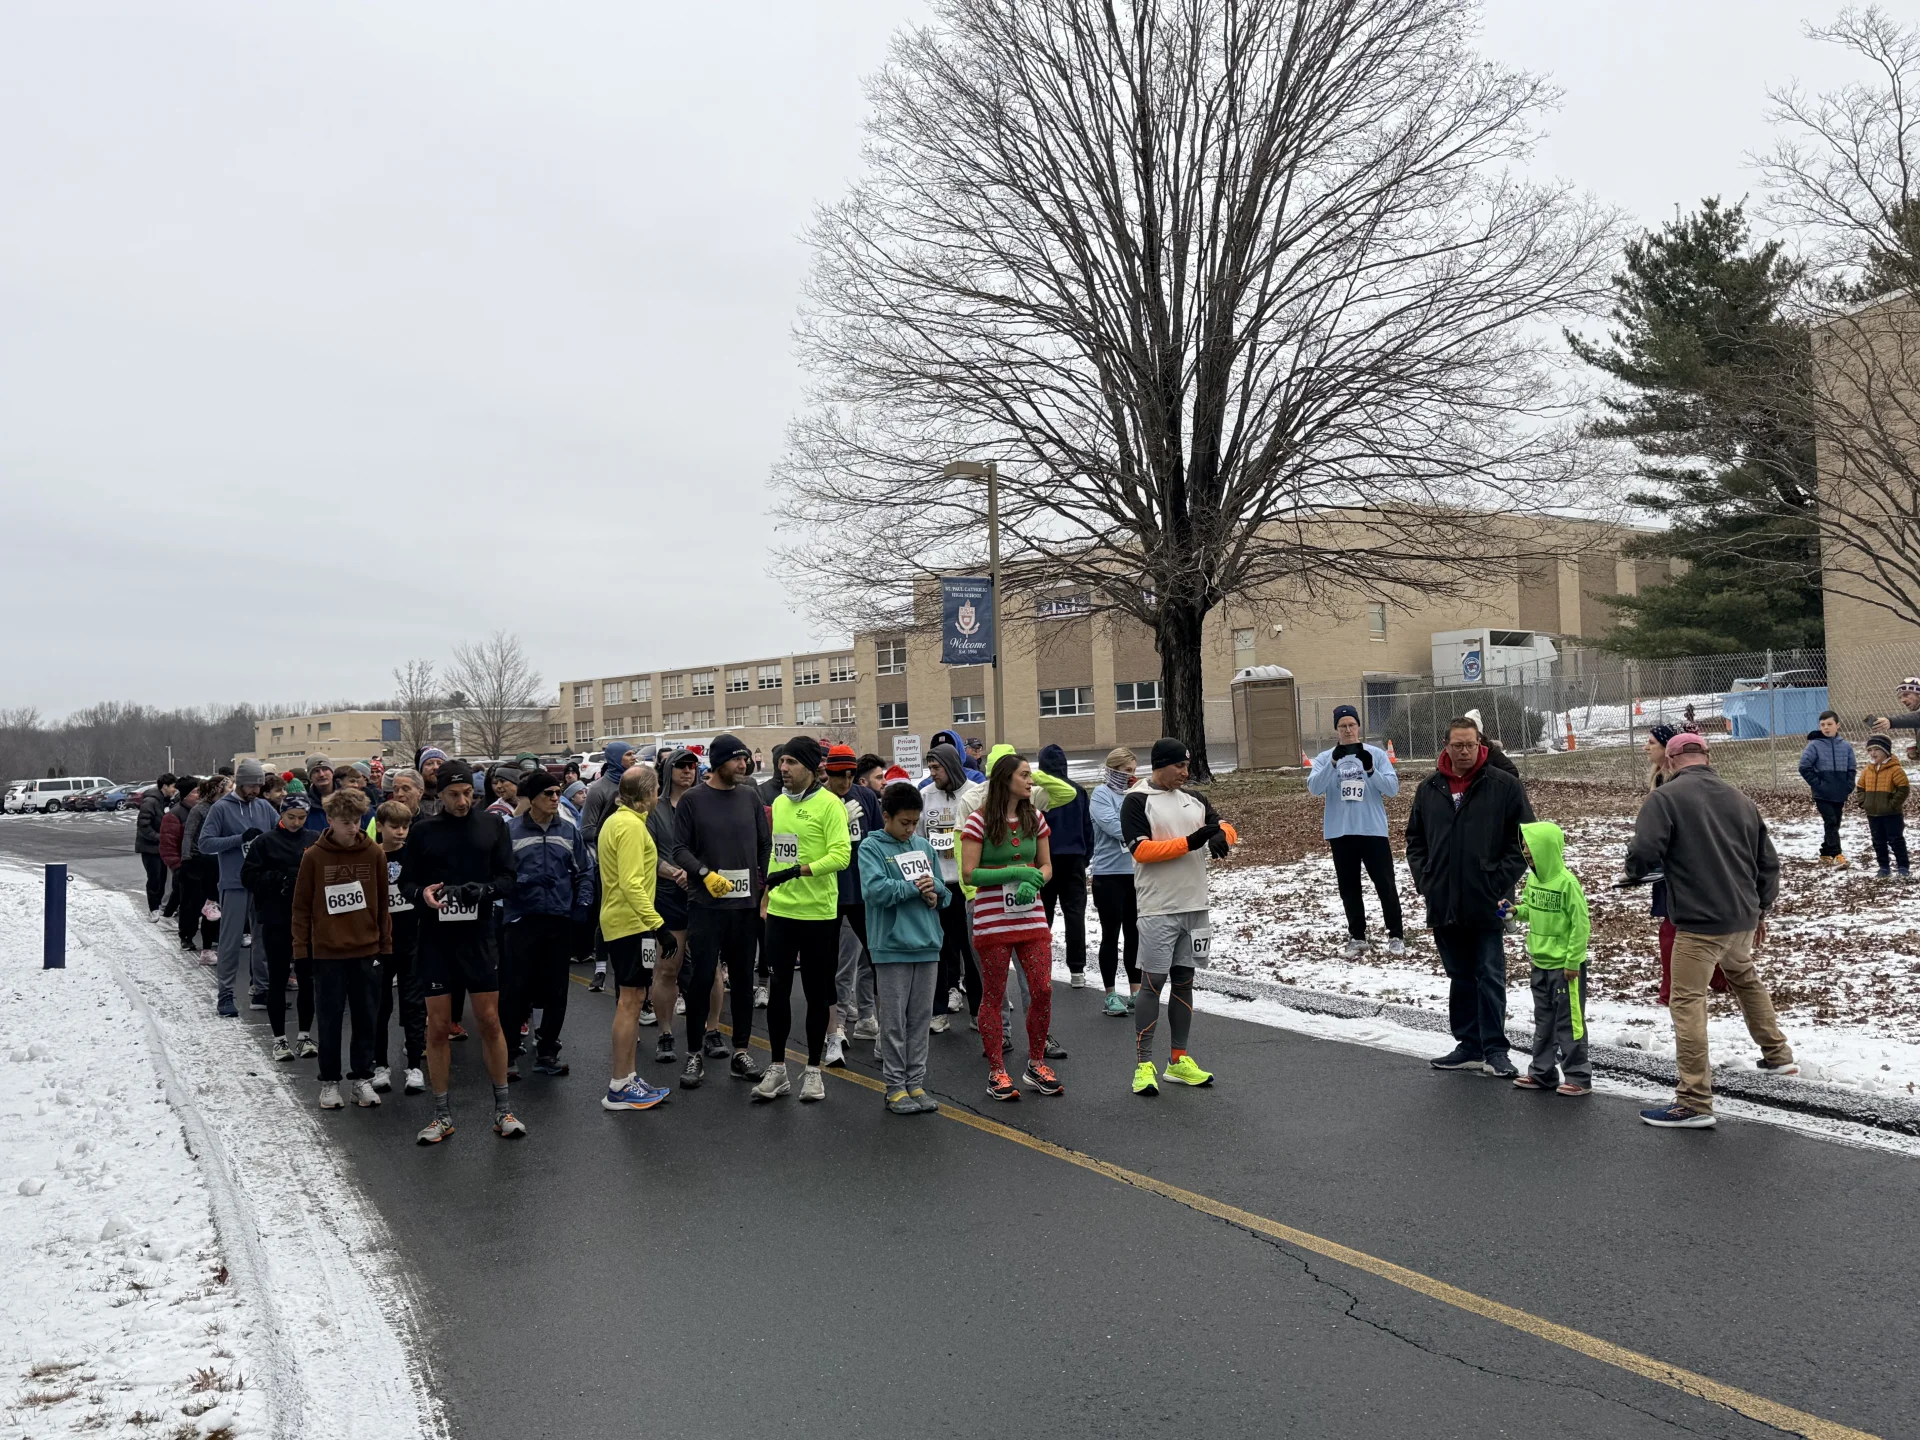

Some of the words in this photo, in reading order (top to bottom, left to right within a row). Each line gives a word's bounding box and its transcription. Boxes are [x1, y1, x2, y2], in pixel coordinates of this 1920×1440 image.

[950, 637, 986, 649] Welcome
[1342, 786, 1363, 797] 6813
[930, 838, 954, 847] 680
[775, 843, 797, 857] 6799
[901, 859, 930, 875] 6794
[328, 890, 364, 908] 6836
